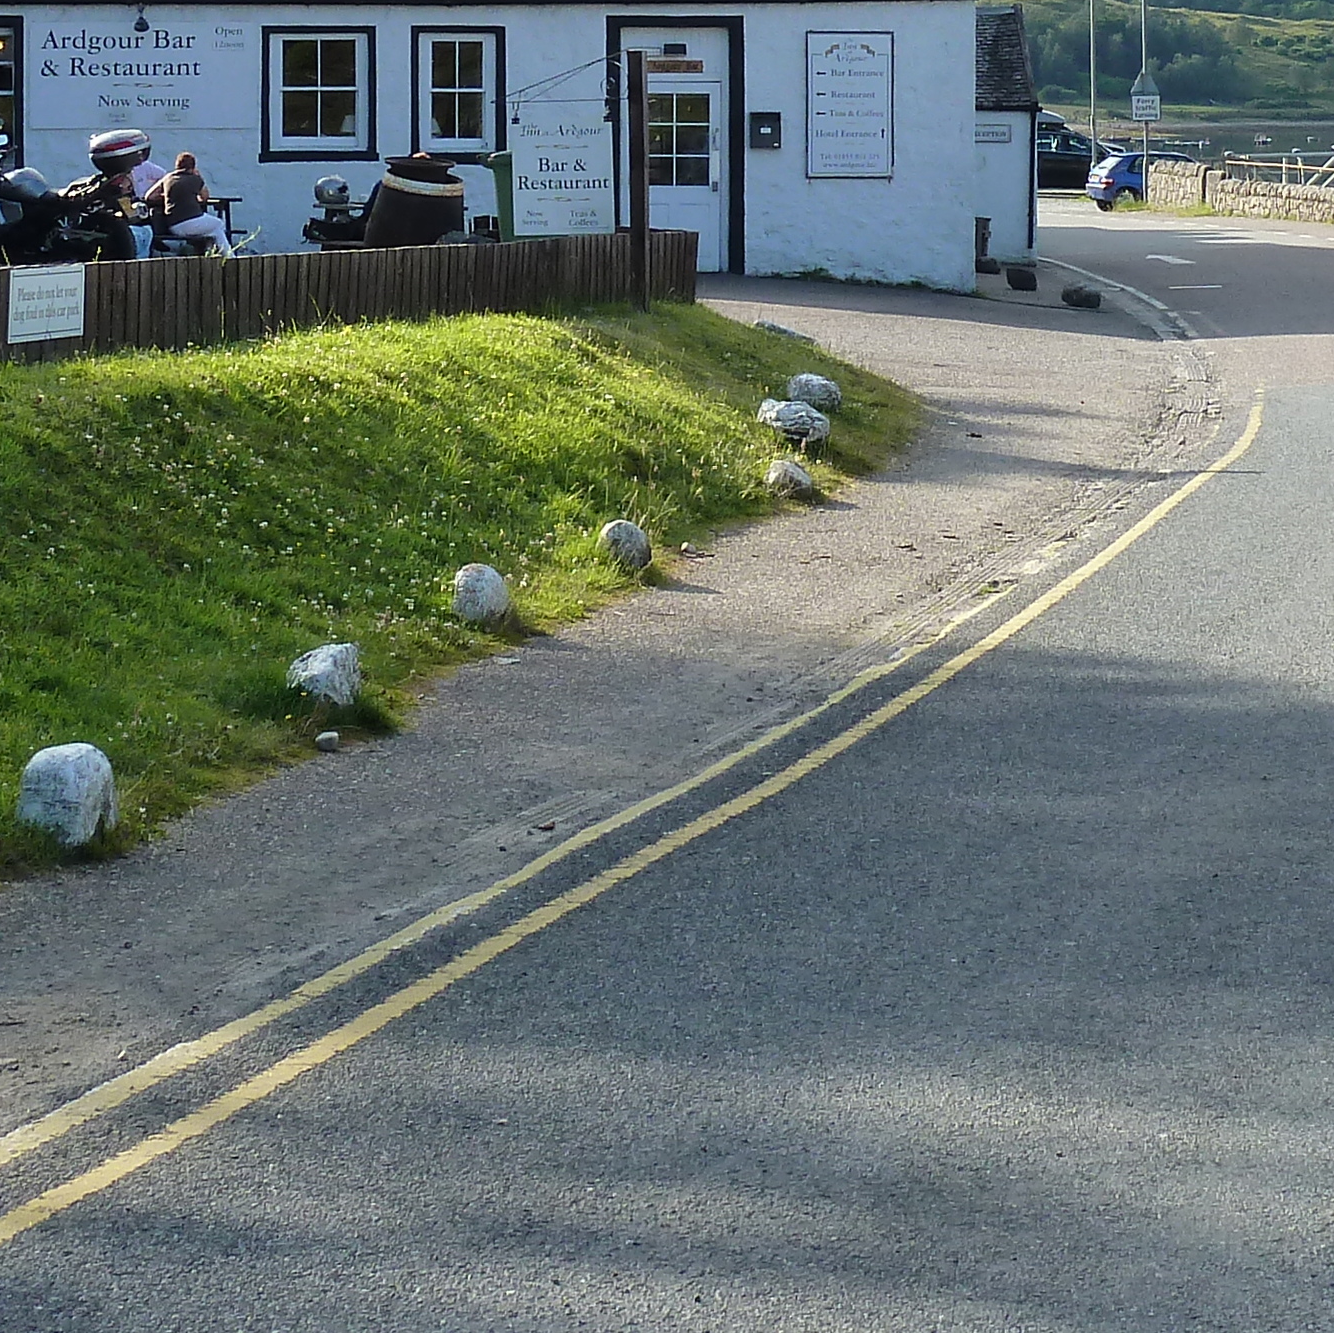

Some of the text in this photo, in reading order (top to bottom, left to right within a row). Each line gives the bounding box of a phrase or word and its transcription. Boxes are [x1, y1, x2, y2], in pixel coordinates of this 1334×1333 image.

[215, 26, 243, 37] Open
[41, 29, 196, 55] Ardgour Bar
[40, 57, 202, 77] & Restaurant
[831, 69, 884, 77] Bar Entrance
[98, 94, 190, 110] Now Serving
[831, 91, 875, 99] Restaurant
[556, 124, 604, 139] Ardgour
[815, 129, 878, 137] Hotel Entrance
[538, 157, 587, 172] Bar &
[518, 175, 609, 190] Restaurant
[569, 218, 598, 226] Coffees
